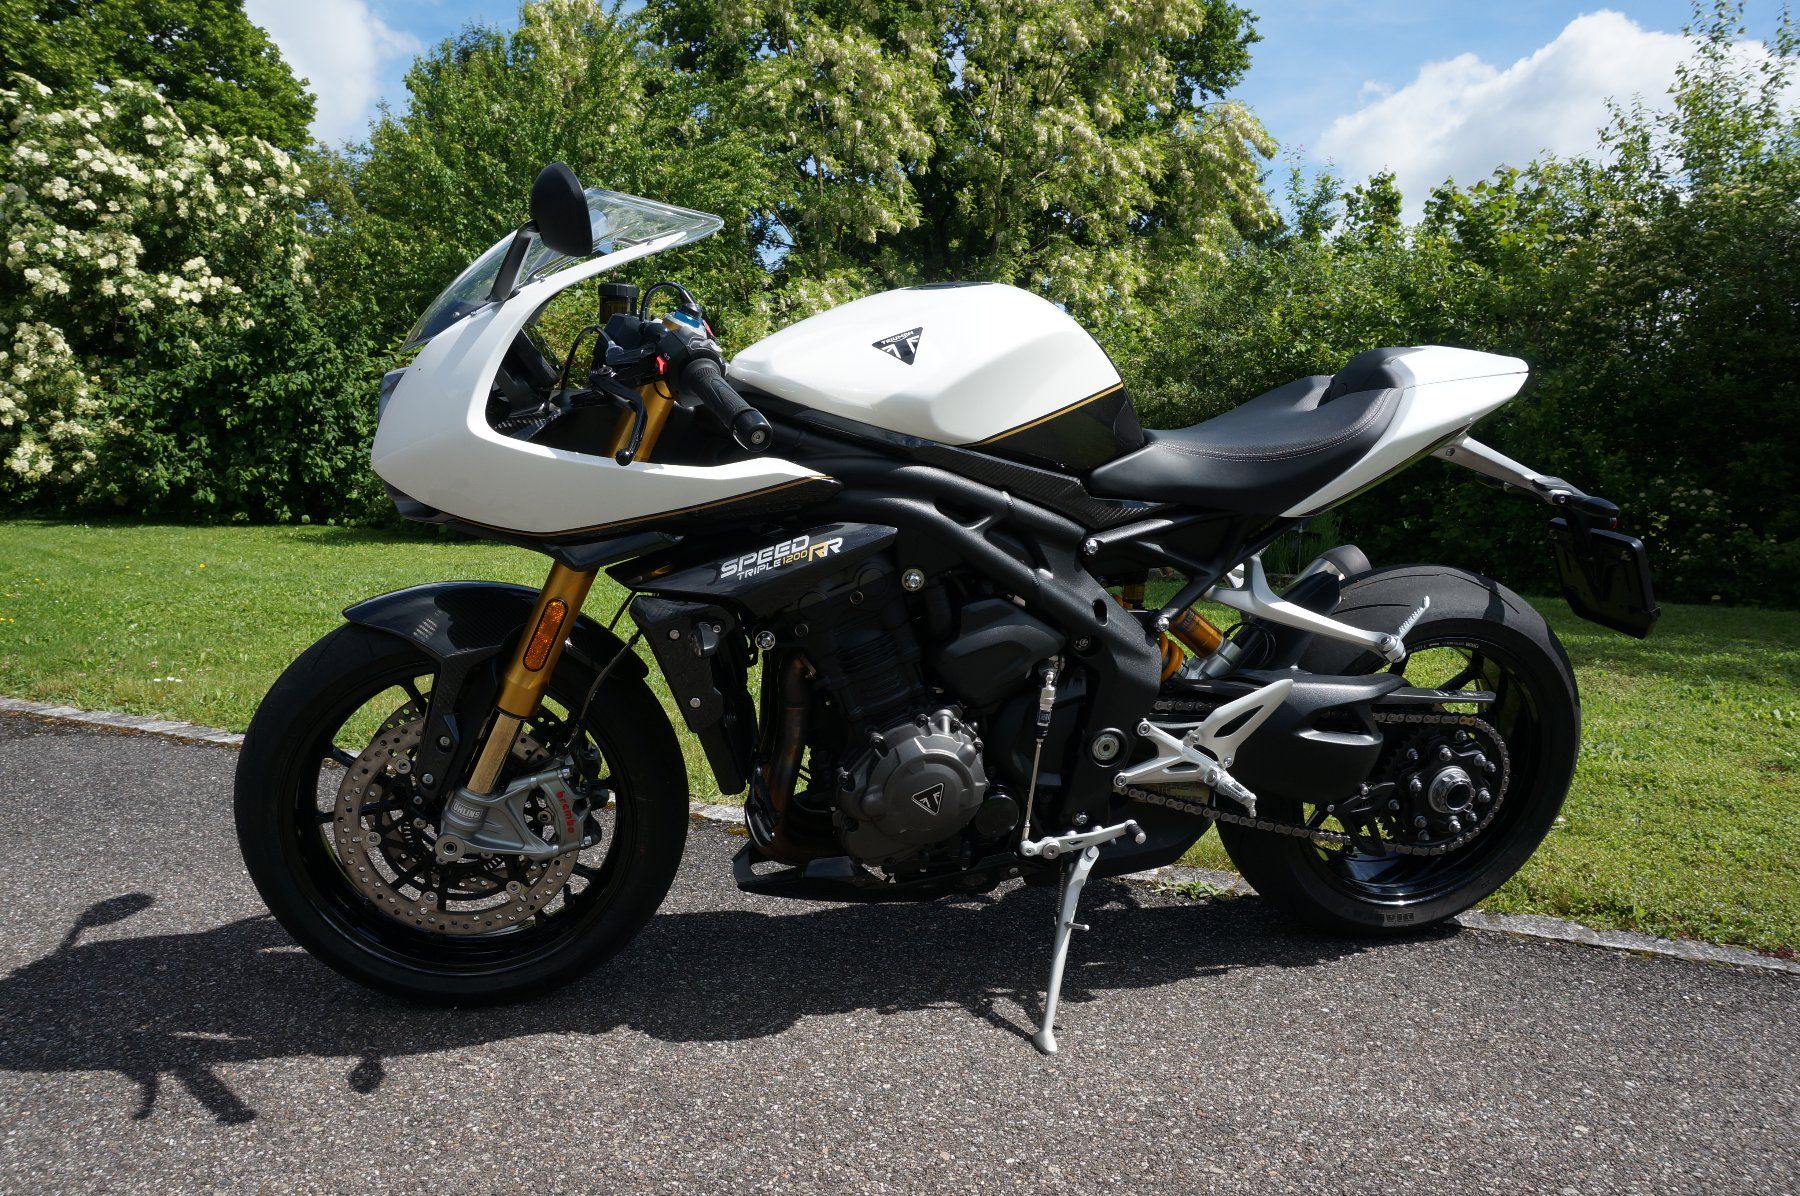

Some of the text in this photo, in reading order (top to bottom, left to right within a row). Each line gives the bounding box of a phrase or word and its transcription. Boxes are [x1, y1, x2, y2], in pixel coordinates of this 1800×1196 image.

[881, 331, 914, 344] TRIUMPH
[720, 535, 810, 579] SPEED
[736, 537, 843, 580] TRIPLE 1200 RR
[556, 790, 577, 833] brembo
